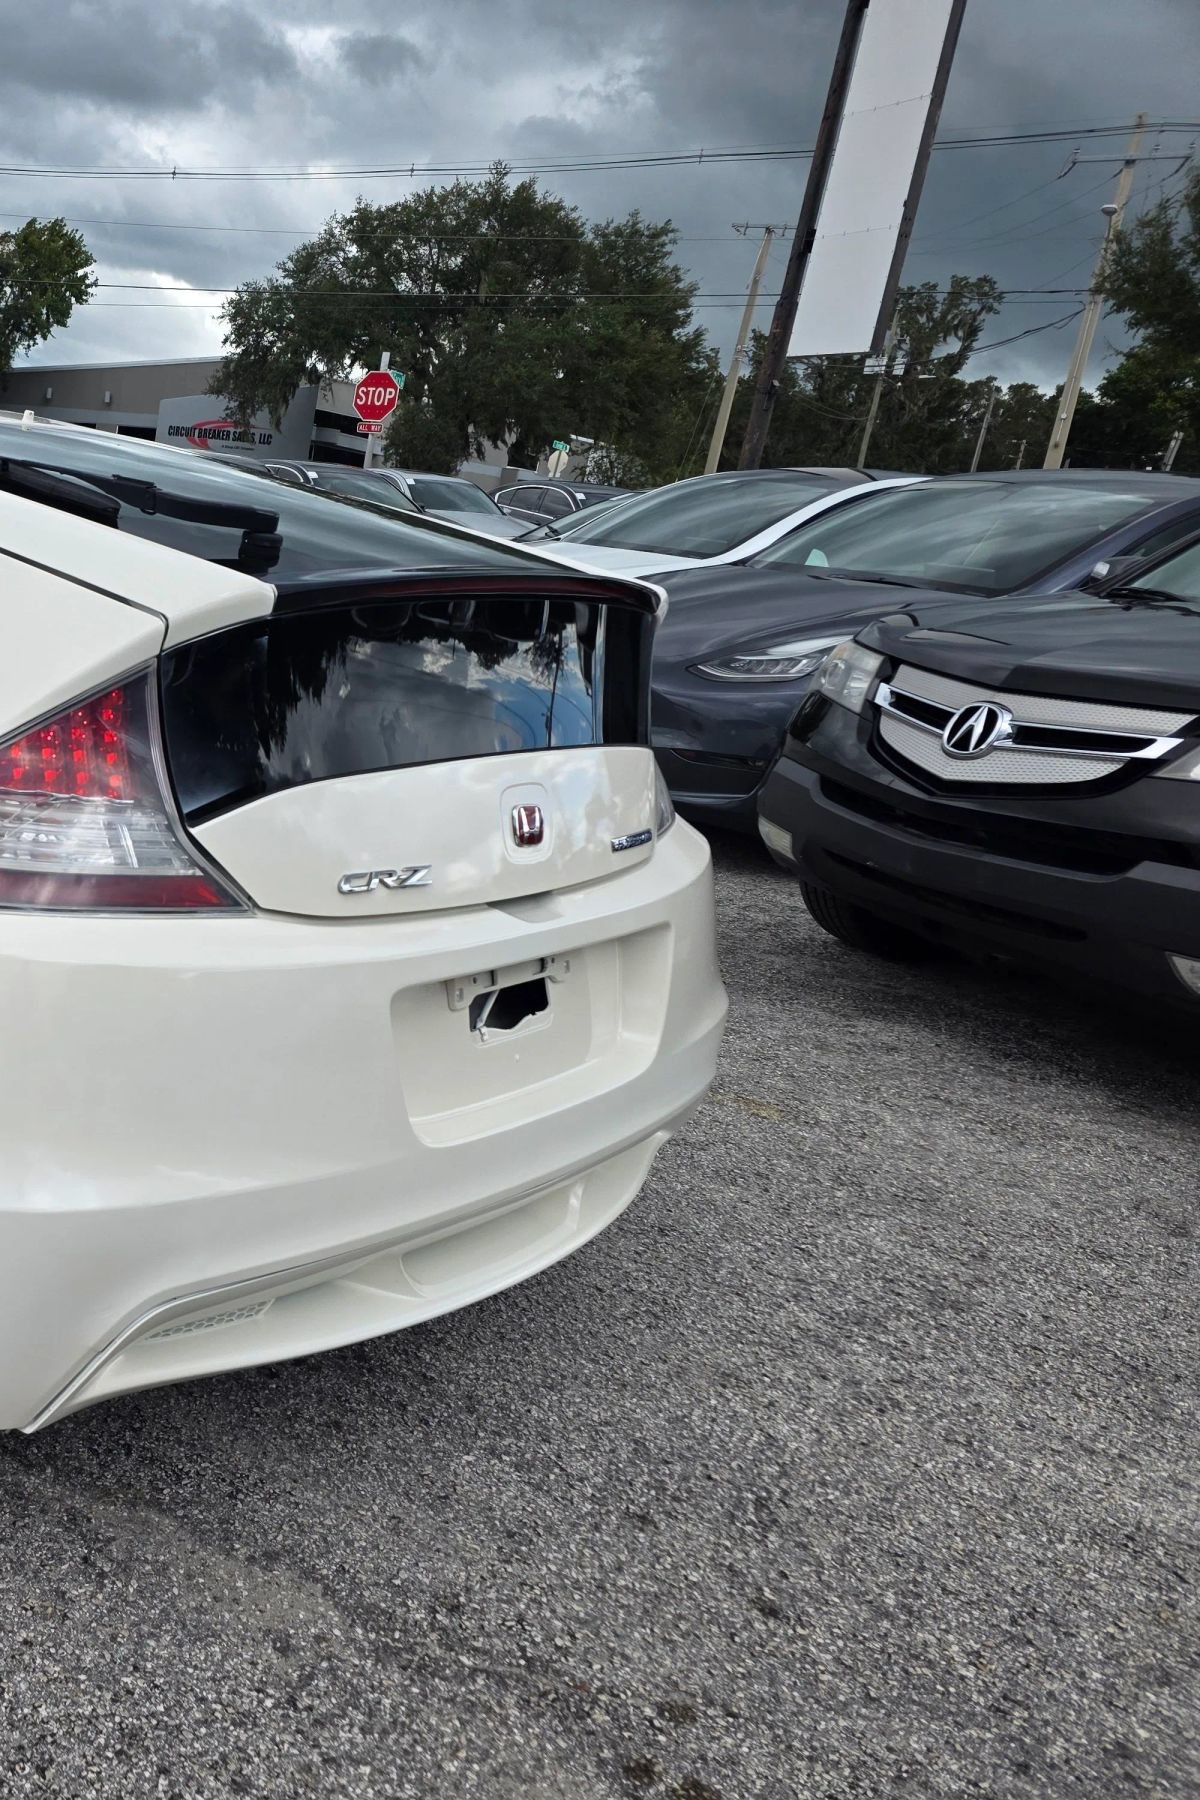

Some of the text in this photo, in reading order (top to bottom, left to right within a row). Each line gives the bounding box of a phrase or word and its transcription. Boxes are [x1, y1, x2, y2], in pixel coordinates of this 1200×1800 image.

[356, 387, 395, 406] STOP
[168, 425, 197, 438] CIRCUIT
[197, 428, 231, 441] BREAKER
[232, 431, 257, 444] SAS,
[258, 434, 273, 446] LLC
